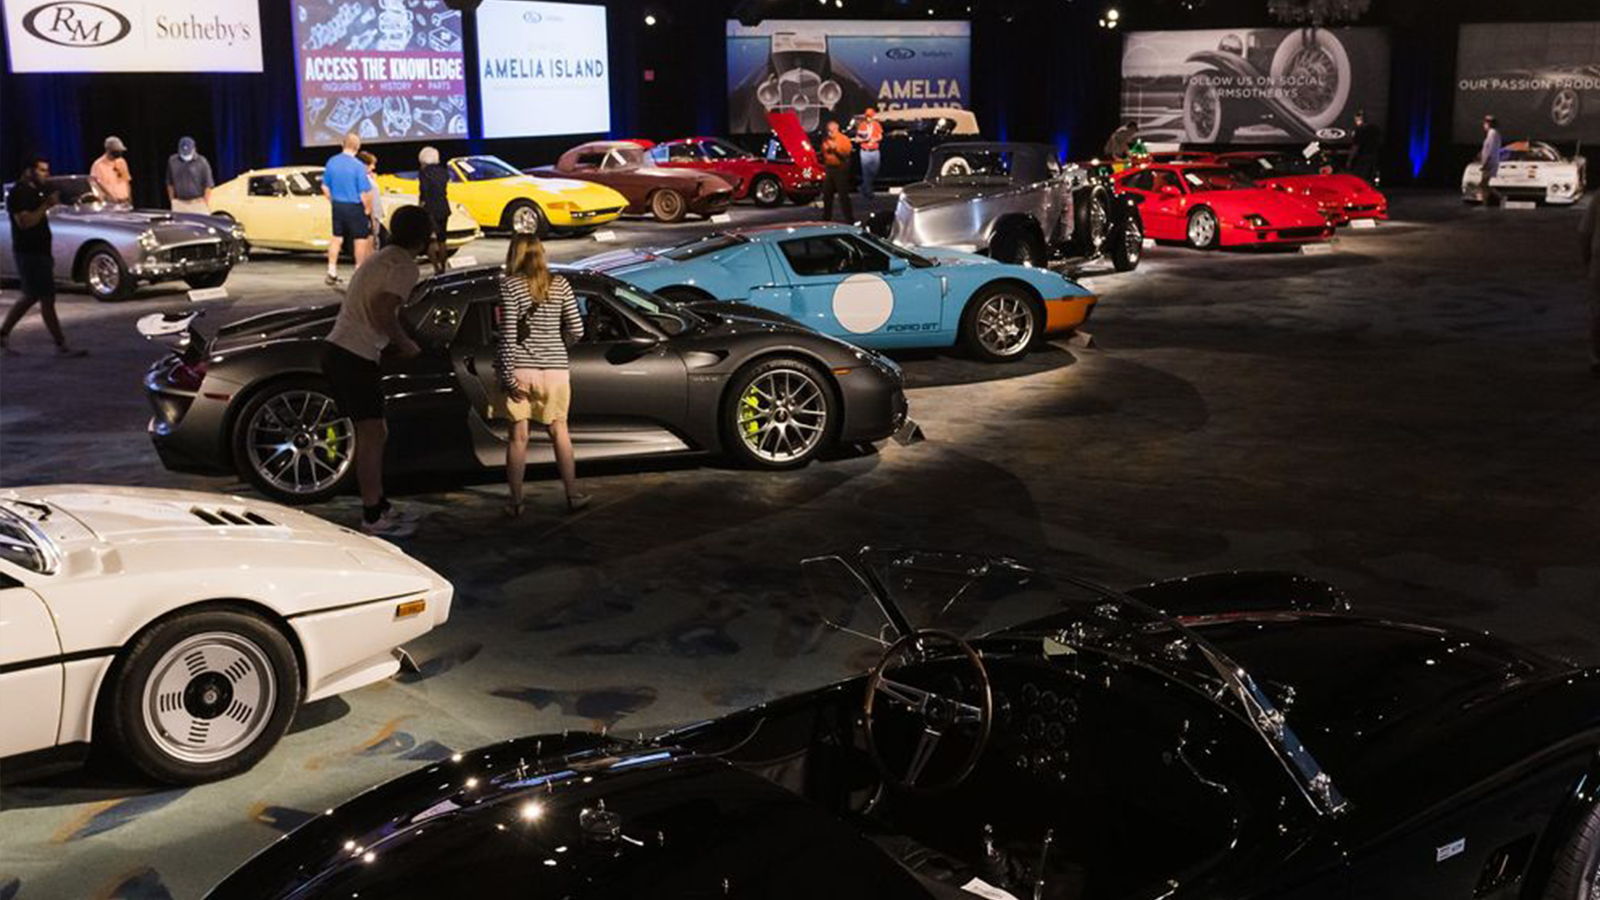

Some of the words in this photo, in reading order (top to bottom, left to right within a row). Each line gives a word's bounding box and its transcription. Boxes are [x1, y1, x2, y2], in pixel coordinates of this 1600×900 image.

[156, 15, 251, 46] Sotheby's
[305, 57, 359, 81] ACCESS
[360, 57, 388, 81] THE
[389, 57, 464, 81] KNOWLEDGE
[484, 58, 545, 78] AMELIA
[549, 58, 604, 78] ISLAND
[878, 79, 961, 99] AMELIA
[1182, 75, 1233, 86] FOLLOW
[1237, 75, 1253, 86] US
[1256, 75, 1276, 86] ON
[1279, 75, 1325, 86] SOCIAL
[1459, 79, 1488, 90] OUR
[1491, 79, 1550, 90] PASSION
